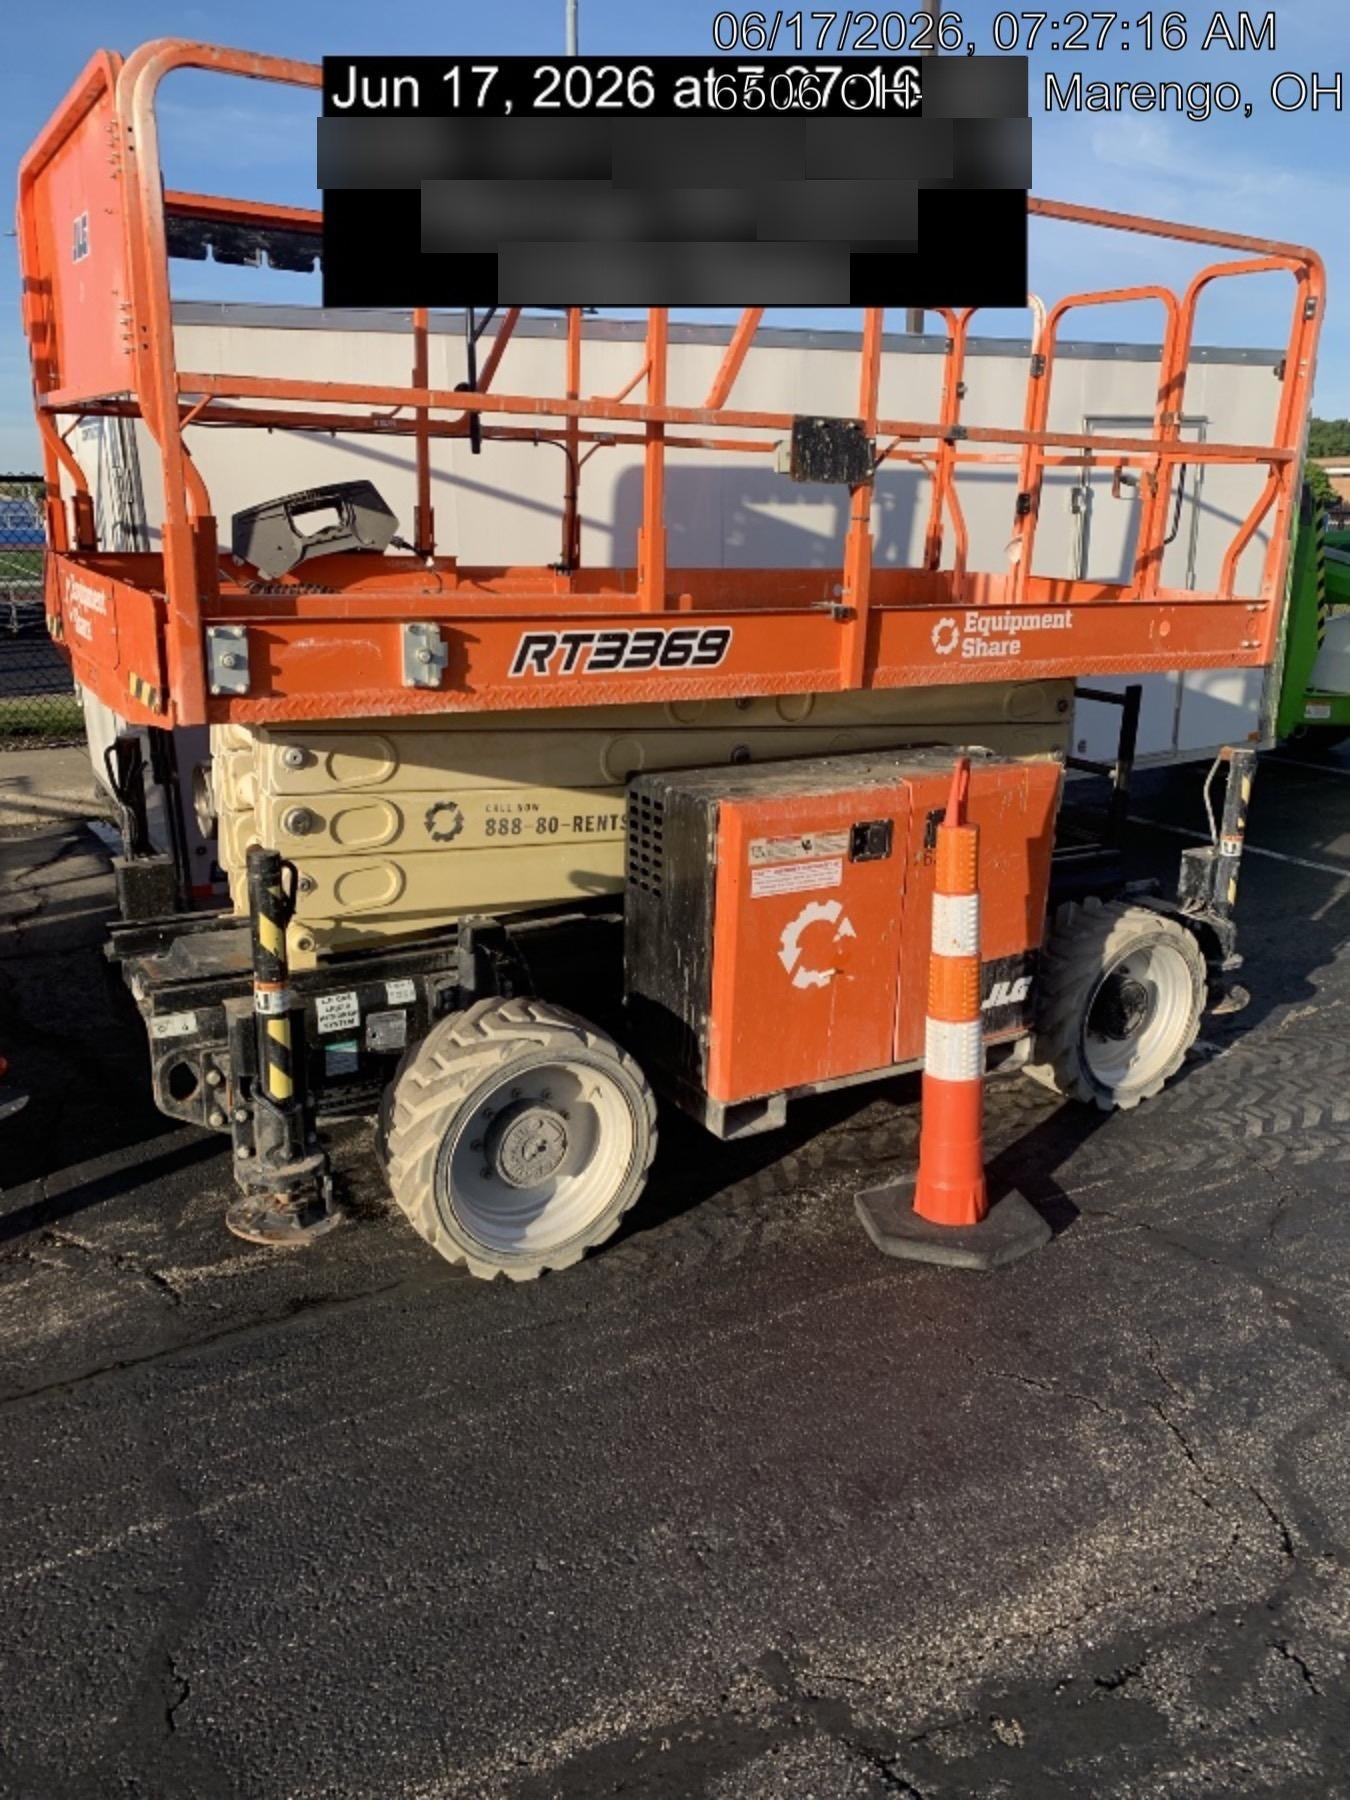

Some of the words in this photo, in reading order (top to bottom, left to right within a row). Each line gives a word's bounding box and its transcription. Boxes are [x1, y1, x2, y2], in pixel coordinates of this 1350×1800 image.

[964, 610, 1072, 636] Equipment
[508, 626, 732, 677] RT3369
[962, 638, 1021, 658] Share
[980, 976, 1033, 1011] JLG
